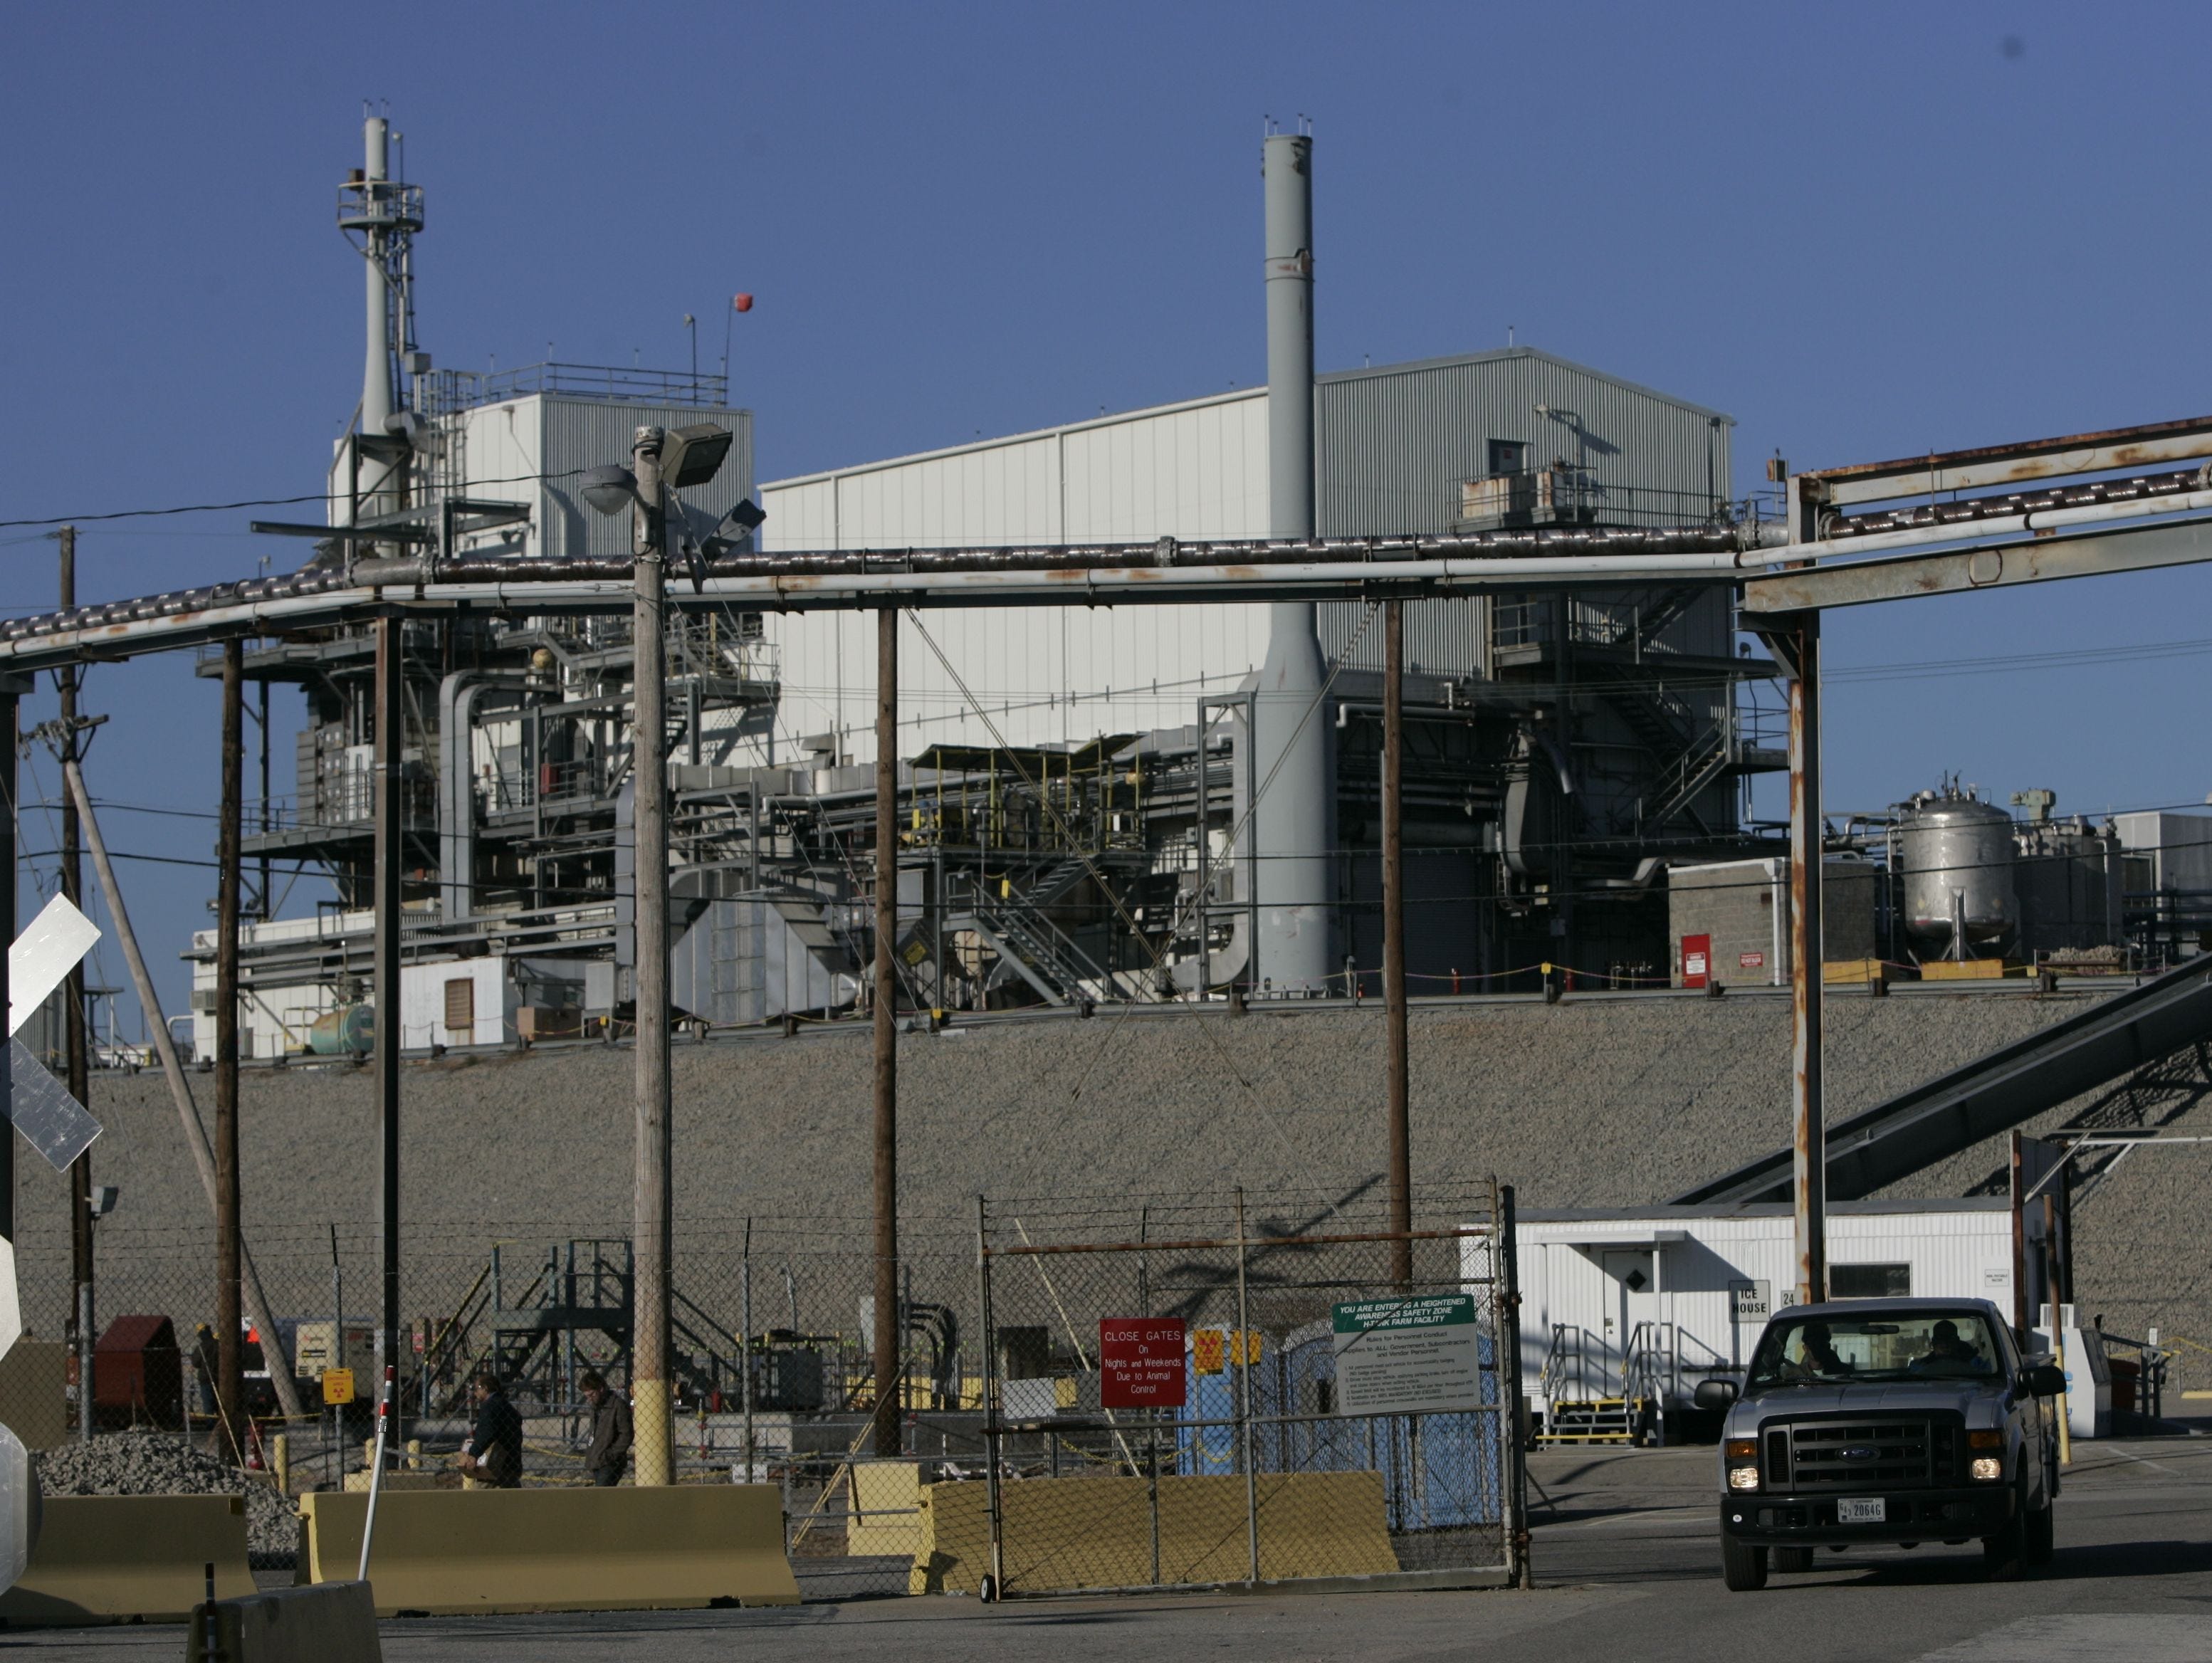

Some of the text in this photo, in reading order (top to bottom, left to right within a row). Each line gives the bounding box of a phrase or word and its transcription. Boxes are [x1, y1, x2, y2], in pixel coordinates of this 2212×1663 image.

[1741, 1289, 1757, 1299] ICE
[1421, 1298, 1466, 1308] HEIGHTENED
[1732, 1303, 1766, 1313] HOUSE
[1403, 1308, 1432, 1317] SAFETY
[1391, 1317, 1412, 1326] FARM
[1414, 1316, 1445, 1324] FACILITY
[1105, 1331, 1180, 1341] CLOSE GATES
[1139, 1345, 1148, 1354] On
[1105, 1359, 1127, 1370] Nights
[1144, 1358, 1181, 1367] Weekends
[1116, 1372, 1131, 1380] Due
[1146, 1371, 1170, 1380] Animal
[1131, 1385, 1155, 1393] Control
